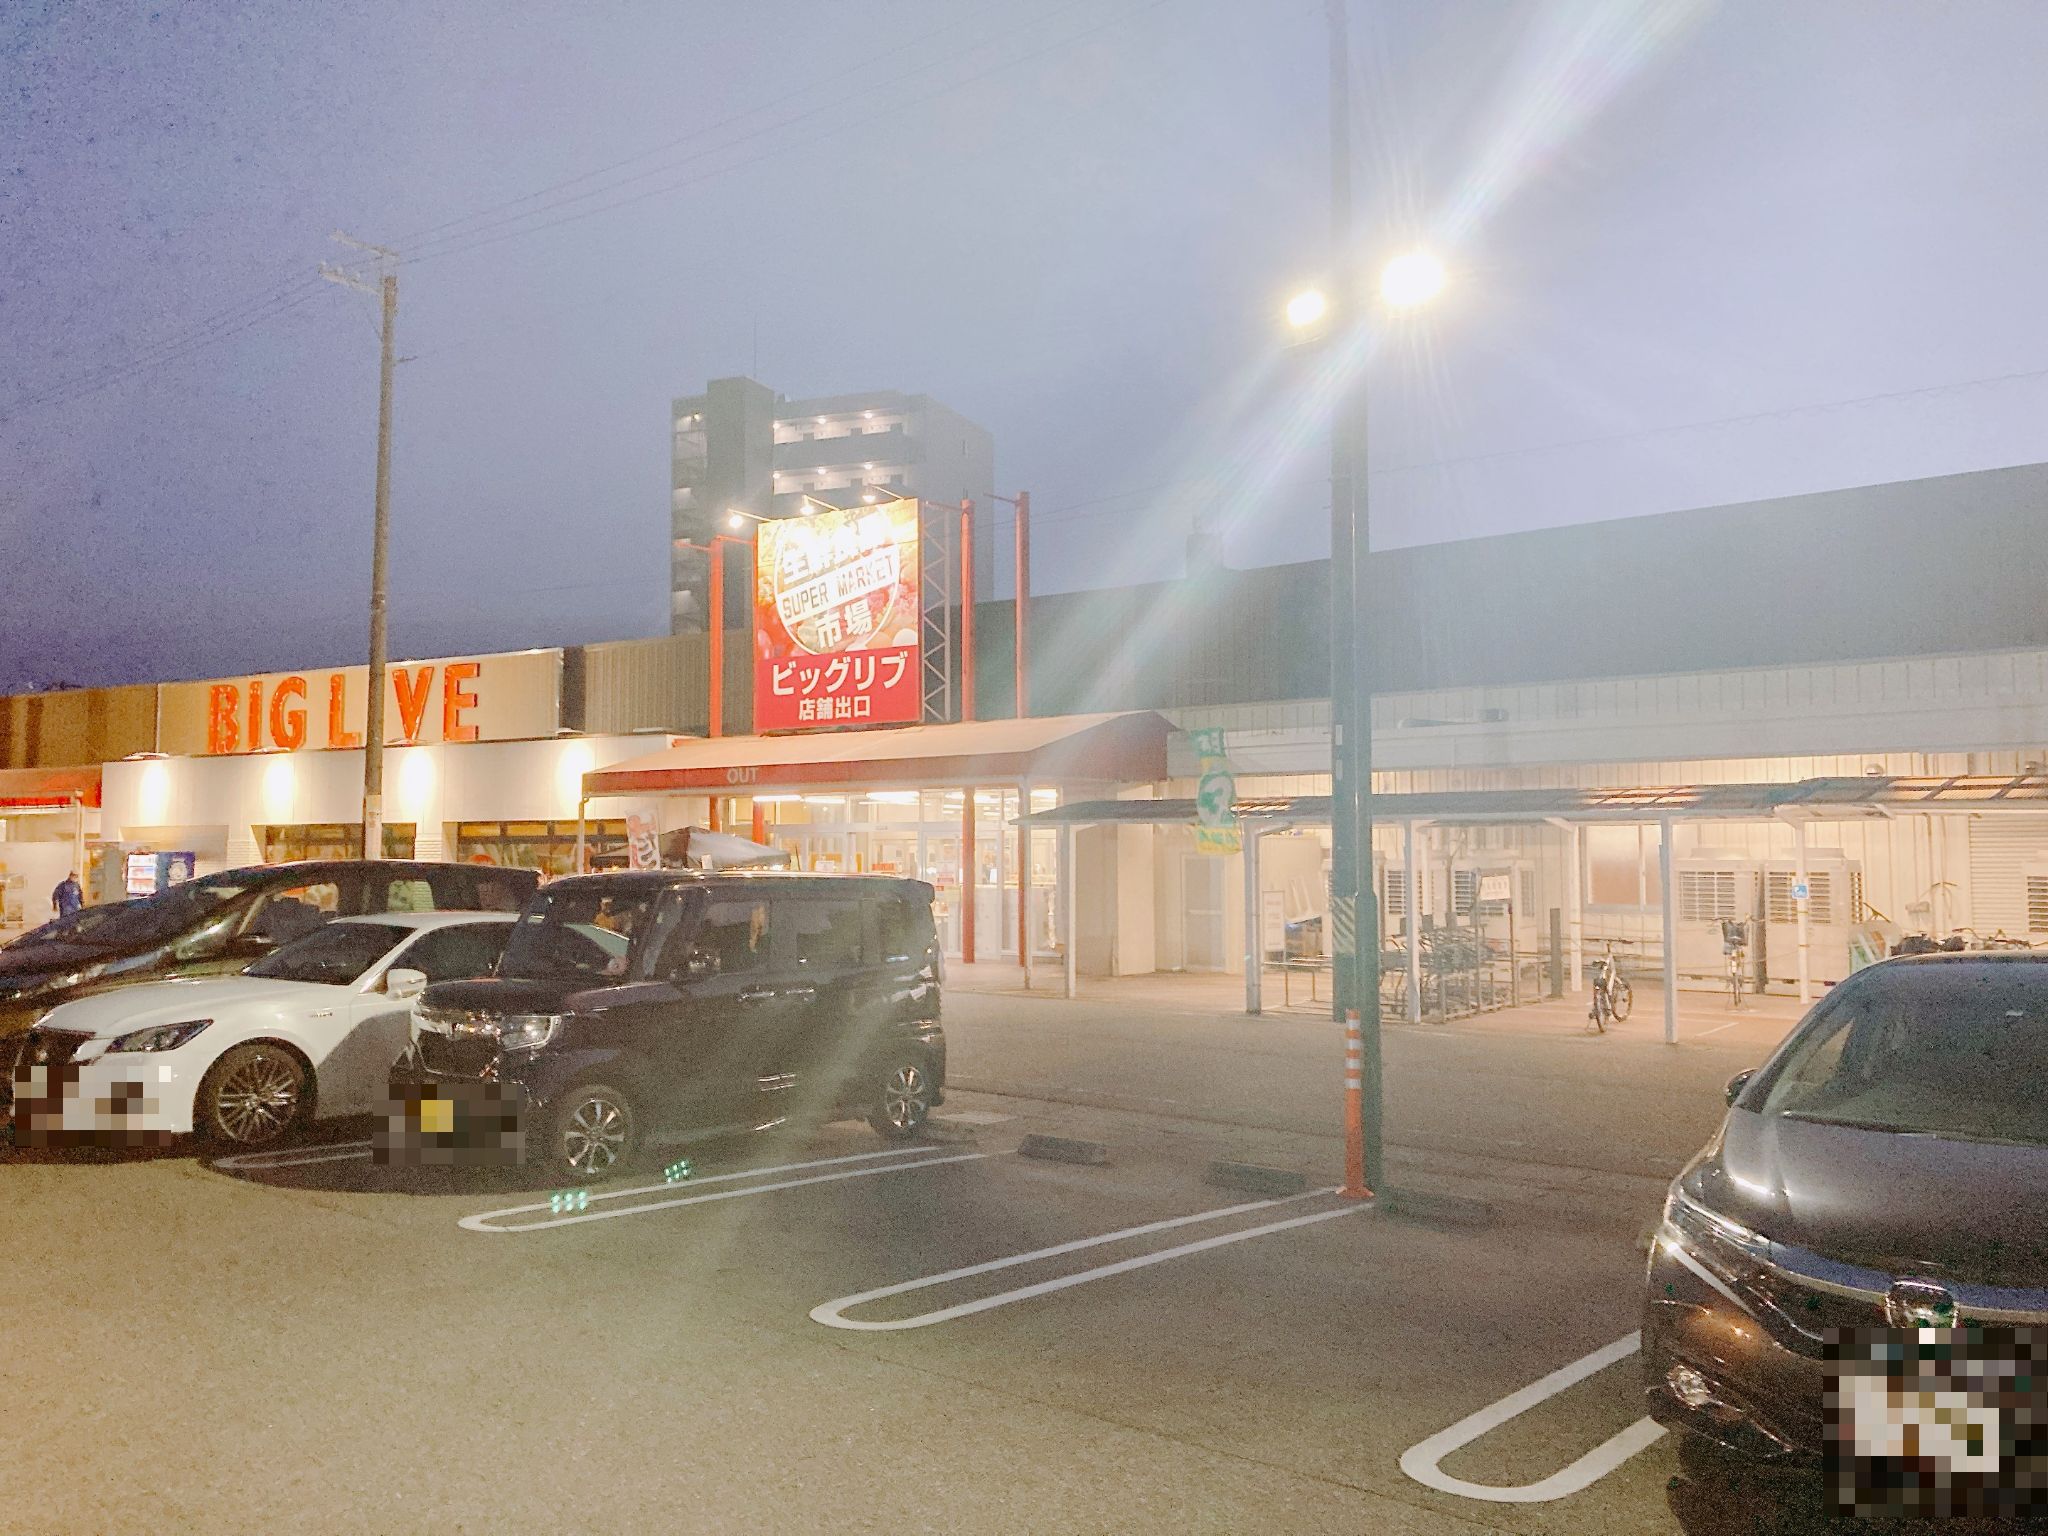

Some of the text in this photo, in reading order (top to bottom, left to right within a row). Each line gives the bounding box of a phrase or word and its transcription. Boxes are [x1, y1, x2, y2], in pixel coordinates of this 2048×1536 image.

[782, 555, 894, 619] SUPER MARKET
[815, 600, 873, 649] 市場
[772, 652, 909, 696] ビッグリブ
[208, 663, 480, 753] BIG LVE
[799, 695, 870, 721] 店舗出口
[727, 767, 759, 784] OUT
